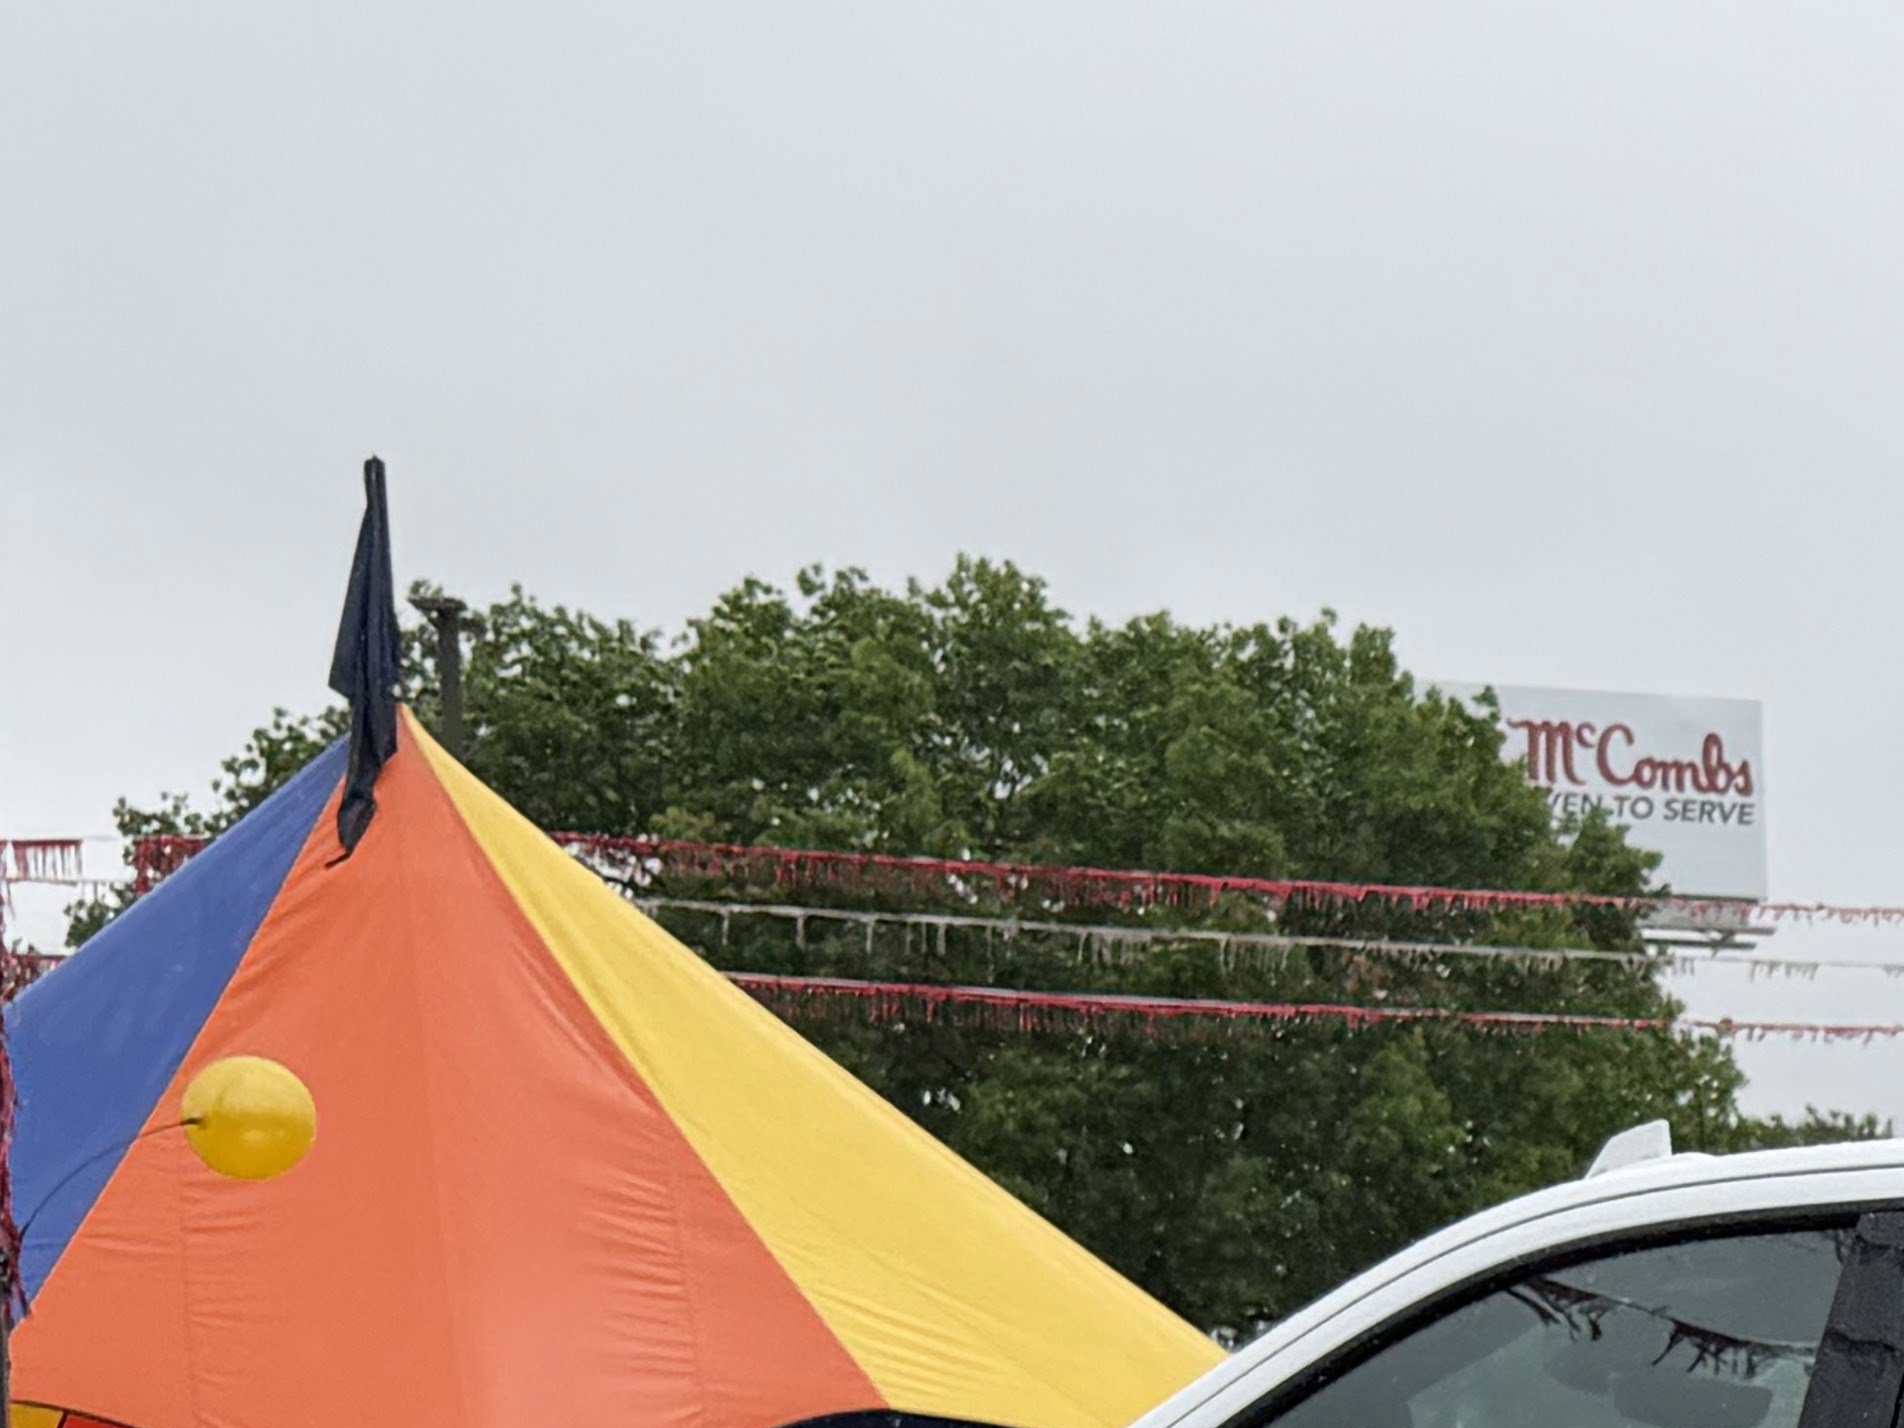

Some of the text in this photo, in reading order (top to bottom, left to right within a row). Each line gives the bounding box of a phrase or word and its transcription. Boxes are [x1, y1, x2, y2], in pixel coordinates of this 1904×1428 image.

[1506, 719, 1754, 797] McCombs
[1611, 796, 1654, 820] TO
[1663, 799, 1755, 825] SERVE
